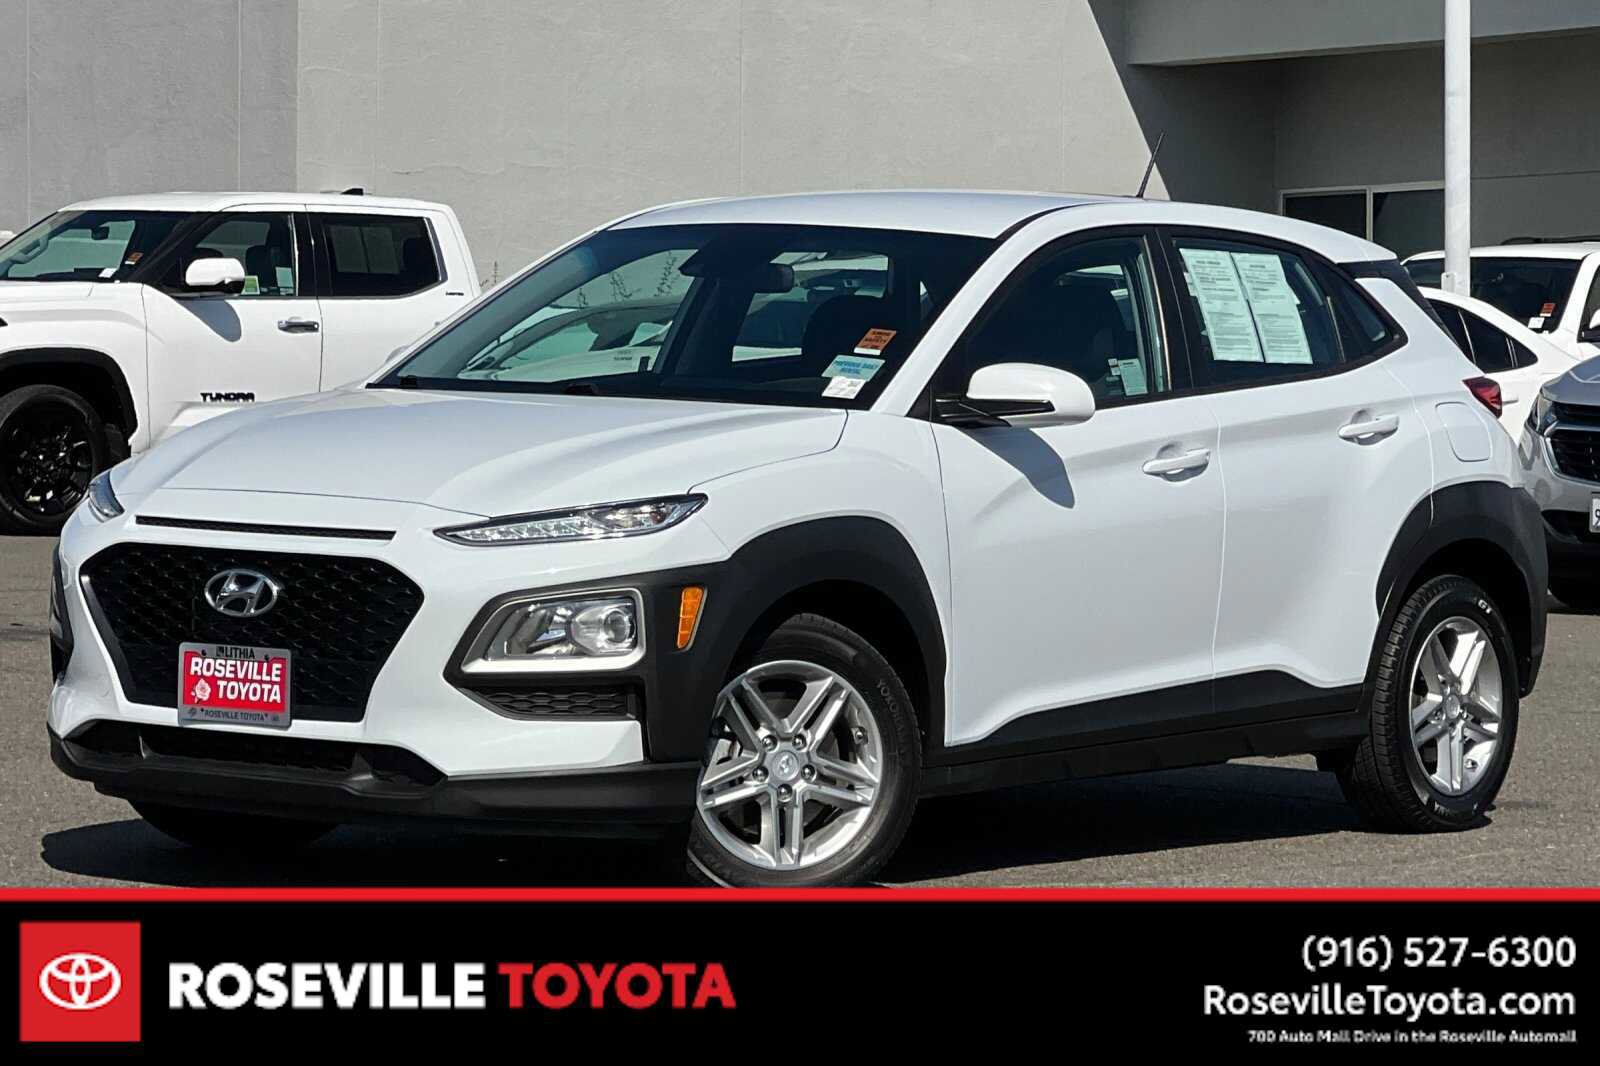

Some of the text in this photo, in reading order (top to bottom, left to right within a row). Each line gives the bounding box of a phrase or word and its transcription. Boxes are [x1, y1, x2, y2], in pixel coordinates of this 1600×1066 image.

[200, 391, 256, 403] TUNDRA
[225, 647, 255, 659] LITHIA
[190, 656, 282, 682] ROSEVILLE
[217, 680, 281, 704] TOYOTA
